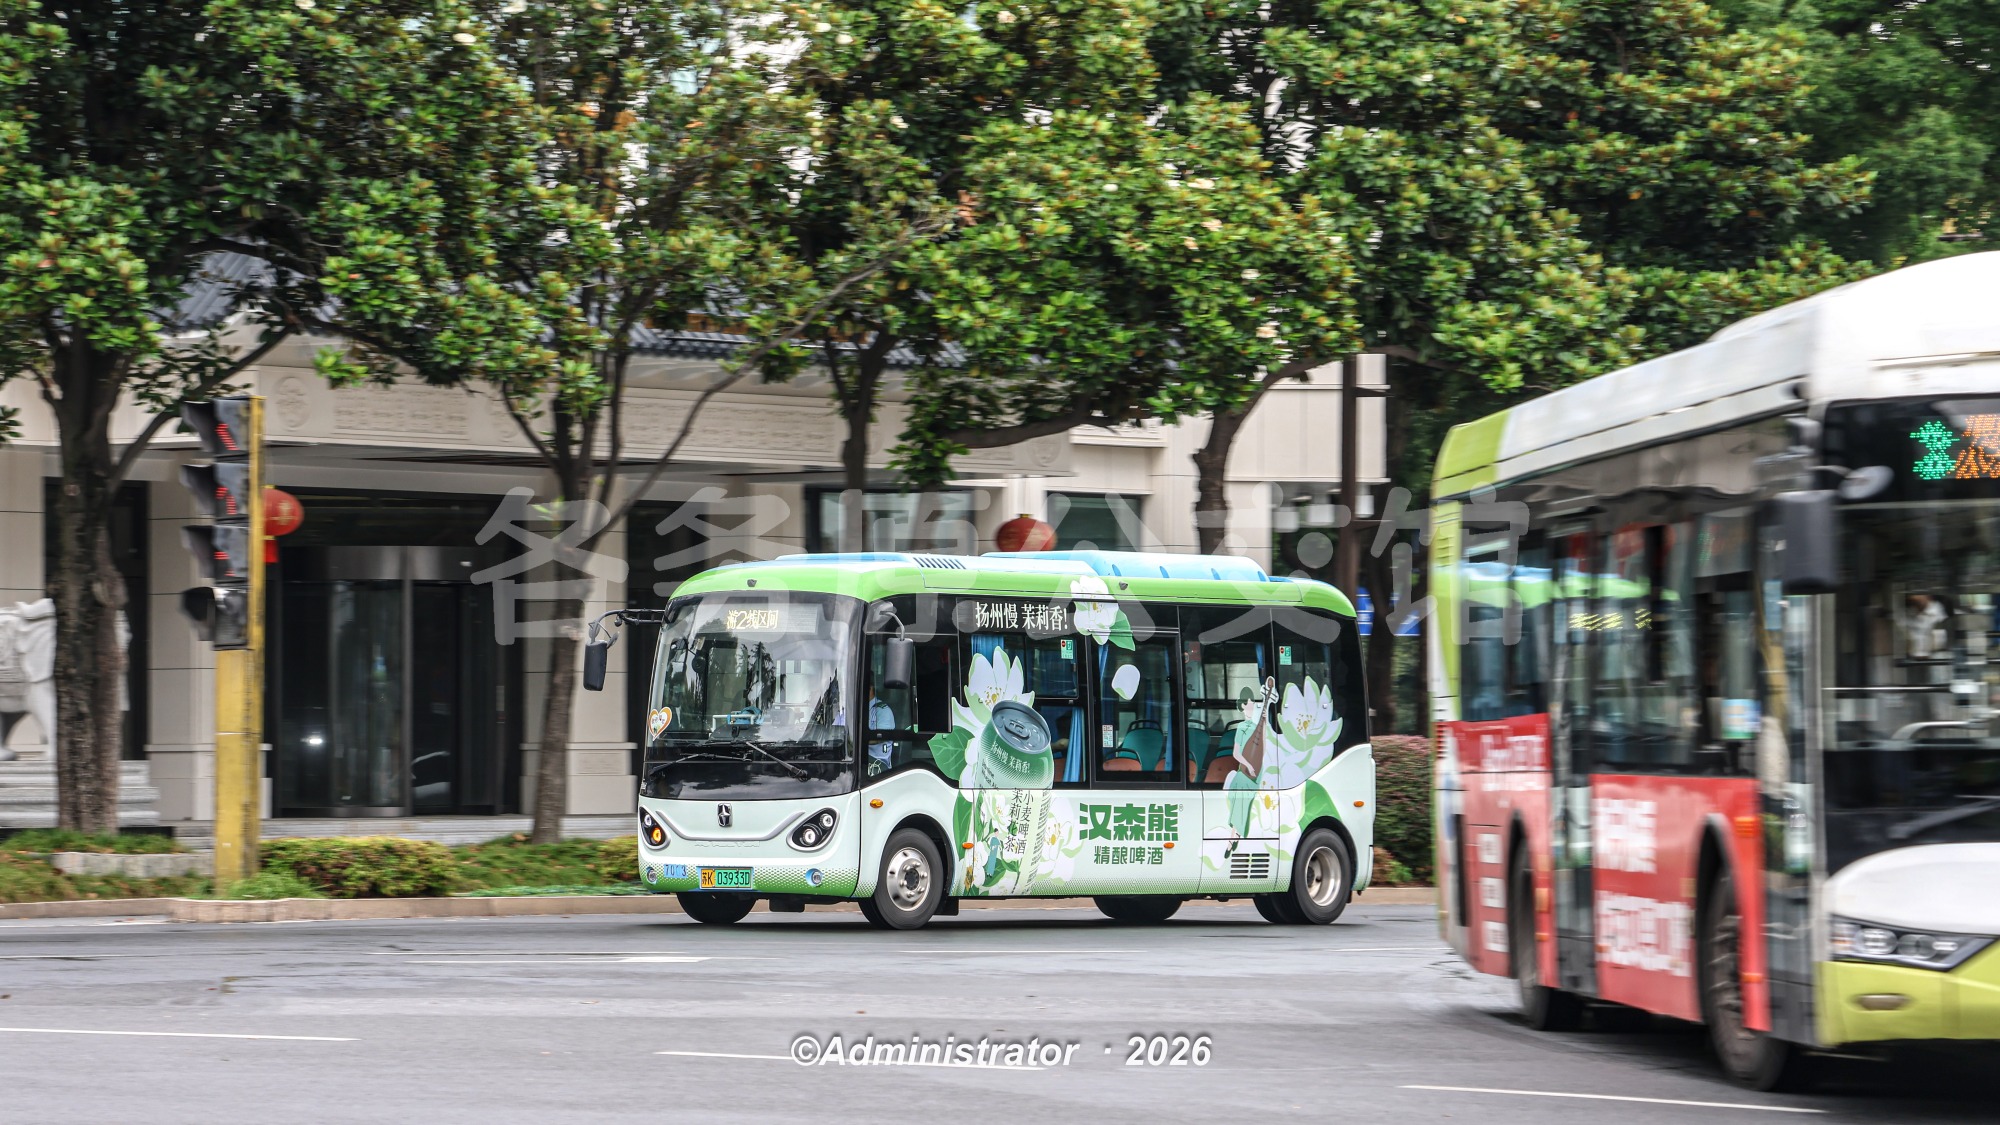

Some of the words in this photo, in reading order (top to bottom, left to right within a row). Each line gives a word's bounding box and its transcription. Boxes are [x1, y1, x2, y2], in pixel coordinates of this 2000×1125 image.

[727, 610, 778, 630] 游2线区间
[975, 602, 1018, 629] 扬州慢
[1021, 604, 1068, 631] 茉莉香!
[1017, 790, 1034, 855] 小麦啤酒
[1079, 803, 1179, 841] 汉森熊
[1094, 846, 1163, 865] 精酿啤酒
[717, 871, 750, 886] 03933D
